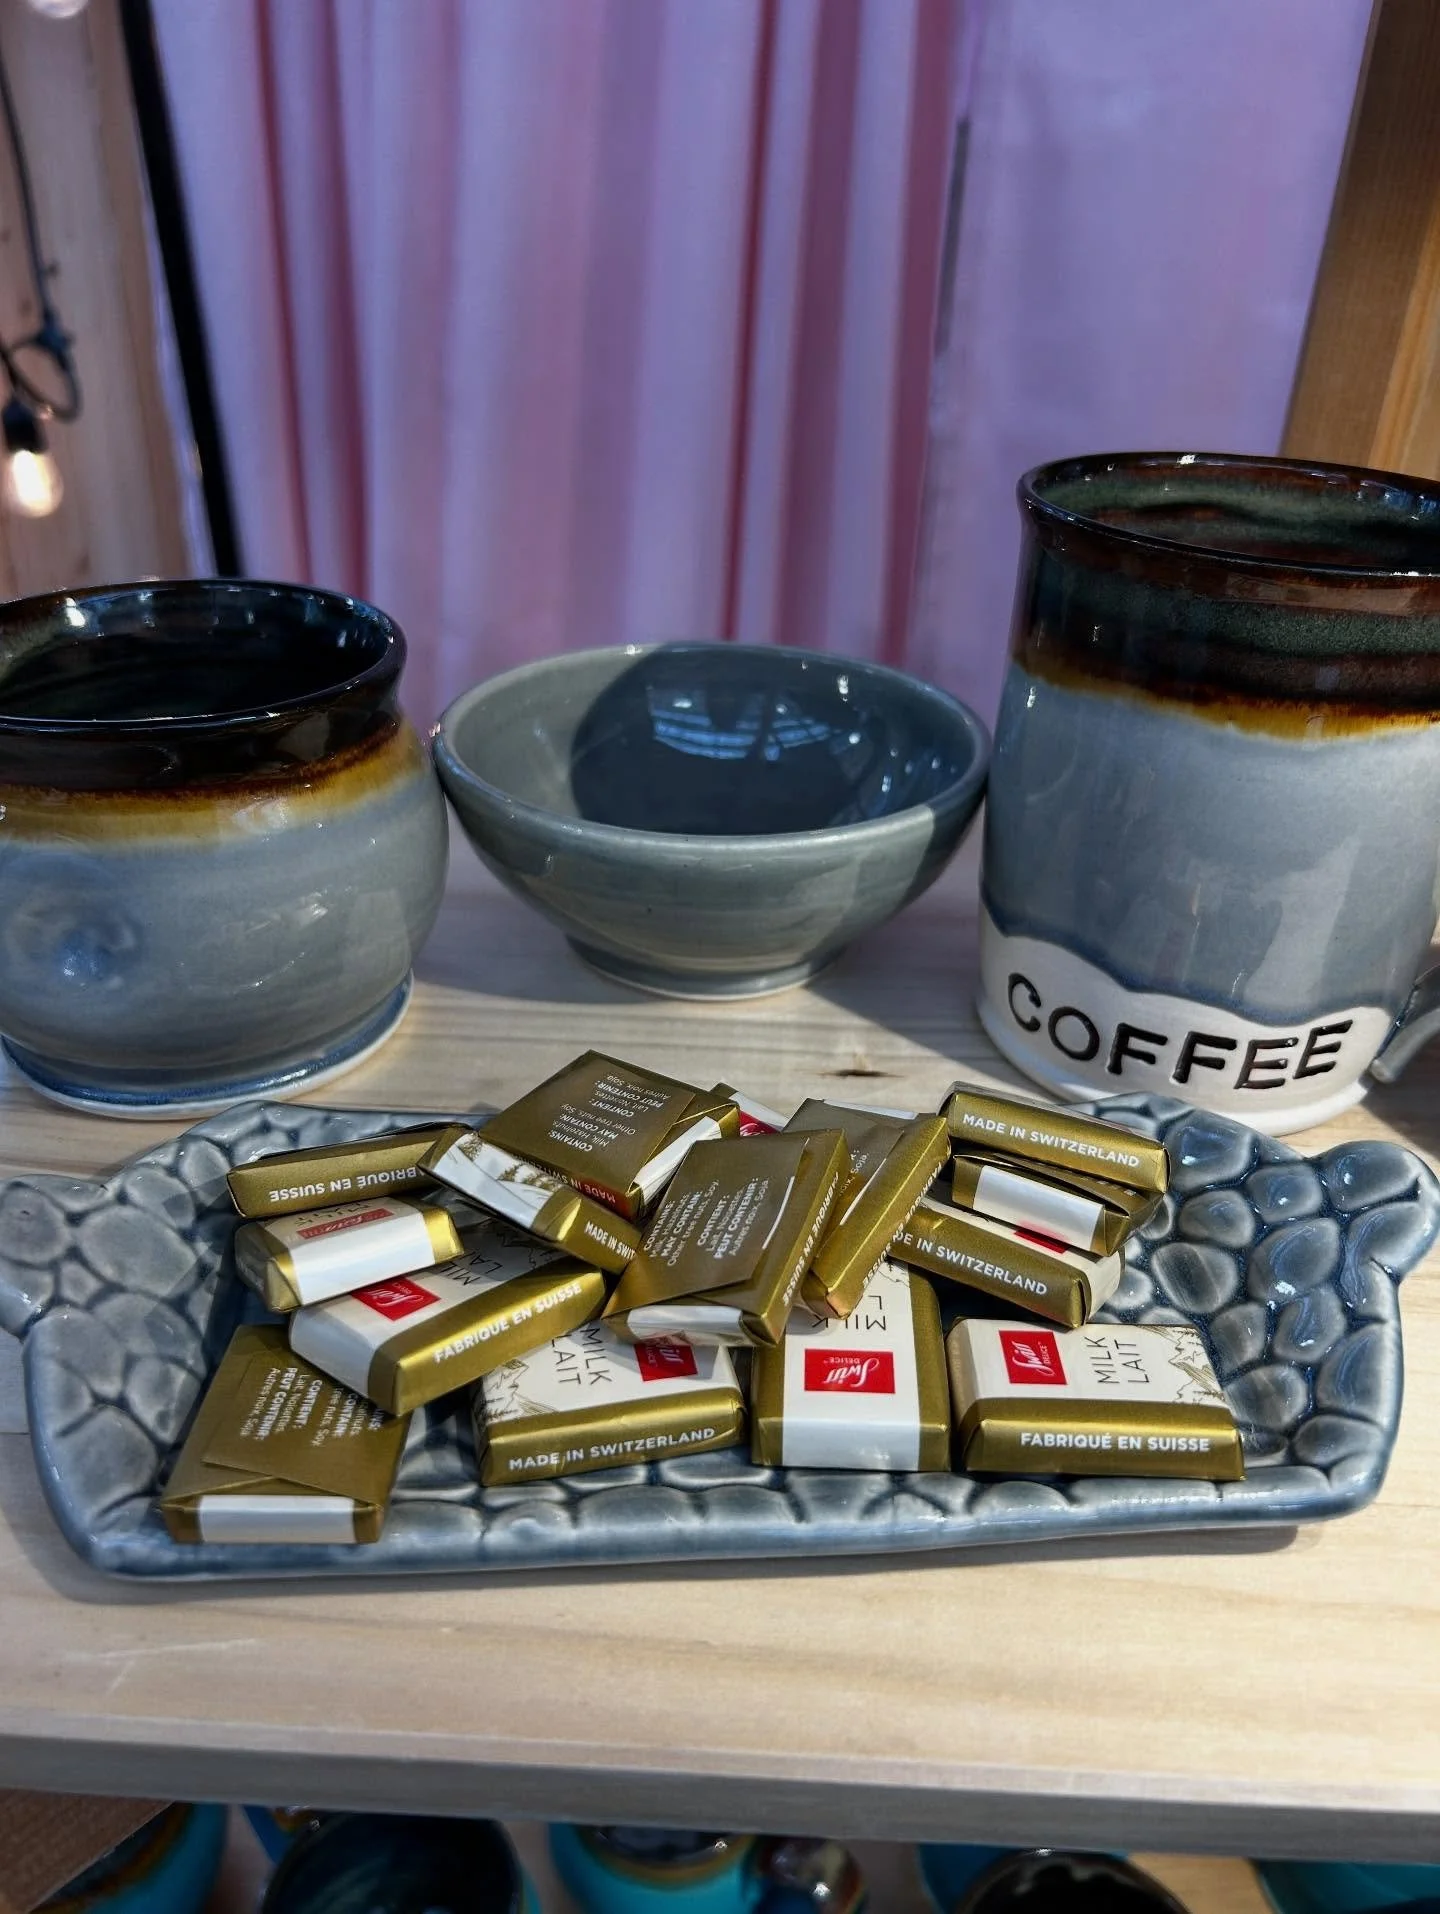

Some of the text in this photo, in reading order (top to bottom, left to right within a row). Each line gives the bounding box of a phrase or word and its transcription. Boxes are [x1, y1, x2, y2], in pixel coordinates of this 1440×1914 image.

[1008, 972, 1353, 1090] COFFEE
[640, 1098, 664, 1108] PEUT
[548, 1130, 593, 1152] CONTAINS:
[560, 1113, 618, 1139] MAY CONTAIN:
[963, 1113, 1140, 1168] MADE IN SWITZERLAND
[269, 1166, 425, 1202] BRIQUÉ EN SUISSE
[584, 1184, 616, 1203] MADE
[584, 1220, 608, 1245] MADE
[607, 1235, 618, 1250] IN
[713, 1233, 733, 1259] PEUT
[803, 1235, 814, 1257] EN
[782, 1256, 805, 1306] SUISSE
[916, 1238, 933, 1253] IN
[937, 1245, 1048, 1296] SWITZERLAND
[512, 1309, 533, 1325] EN
[536, 1282, 582, 1314] SUISSE
[552, 1335, 581, 1385] LAIT
[580, 1328, 612, 1385] MILK
[1084, 1336, 1120, 1384] MILK
[1114, 1339, 1150, 1383] LAIT
[279, 1368, 298, 1390] PEUT
[508, 1428, 715, 1471] MADE IN SWITZERLAND
[1020, 1432, 1211, 1452] FABRIQUÉ EN SUISSE
